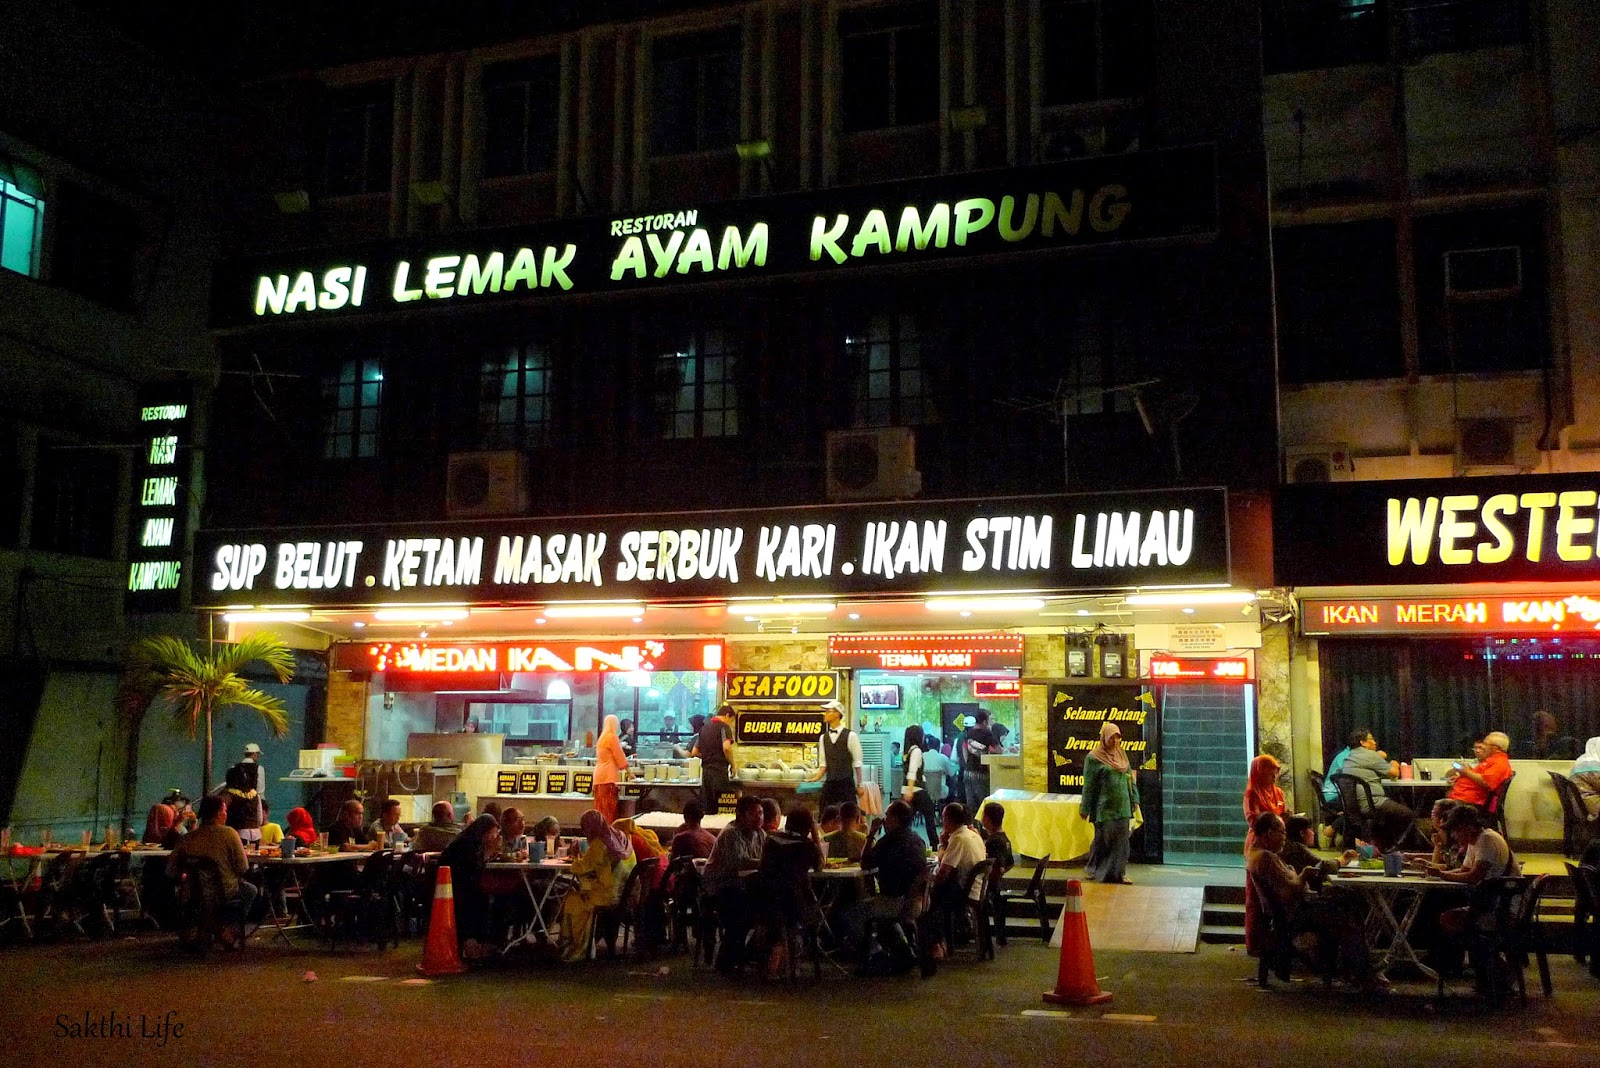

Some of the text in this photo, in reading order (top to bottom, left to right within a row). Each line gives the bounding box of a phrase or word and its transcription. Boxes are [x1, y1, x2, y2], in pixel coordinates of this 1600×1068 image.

[610, 209, 698, 237] RESTORAN
[254, 183, 1132, 316] NASI LEMAK AYAM KAMPUNG
[141, 405, 187, 421] RESTORAN
[150, 436, 178, 464] NASI
[142, 477, 178, 506] LEMAK
[142, 518, 174, 546] AYAM
[1387, 490, 1600, 566] WESTE
[211, 508, 1194, 591] SUP BELUT KETAM MASAK SERBUK KARI IKAN STIM LIMAU
[128, 561, 181, 592] KAMPUNG
[1323, 604, 1378, 624] IKAN
[1396, 602, 1488, 624] MERAH
[1502, 601, 1565, 622] IKAN
[410, 647, 497, 672] MEDAN
[879, 653, 972, 667] TERIMA KASIH
[729, 675, 834, 697] SEAFOOD
[743, 721, 822, 734] BUBUR MANIS
[1063, 706, 1148, 725] Selamat Datang
[1121, 738, 1147, 751] urau
